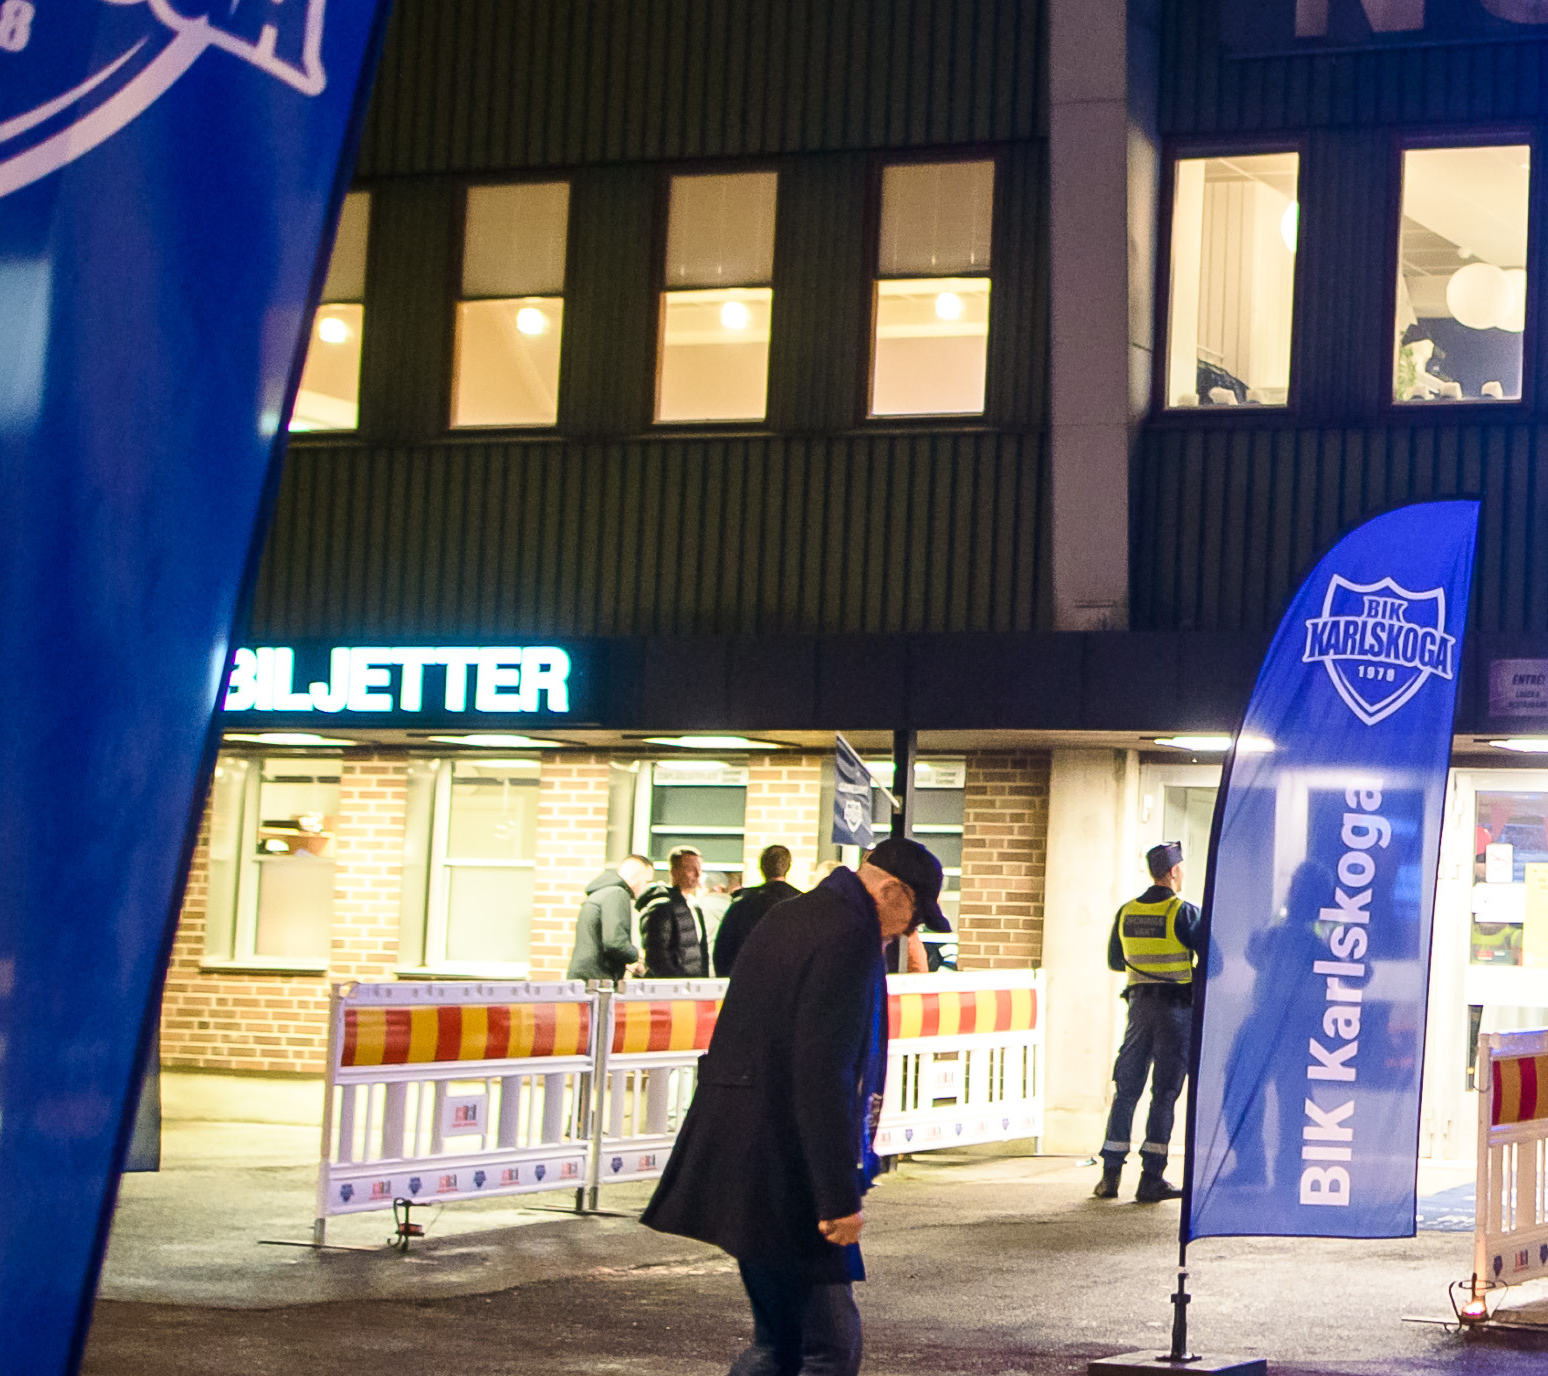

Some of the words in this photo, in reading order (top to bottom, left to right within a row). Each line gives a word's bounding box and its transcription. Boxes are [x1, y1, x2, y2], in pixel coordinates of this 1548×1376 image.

[1309, 619, 1450, 672] KARLSKOGA
[1366, 598, 1402, 621] BIK
[1306, 778, 1392, 1082] Karlskoga
[1299, 1098, 1356, 1207] BIK
